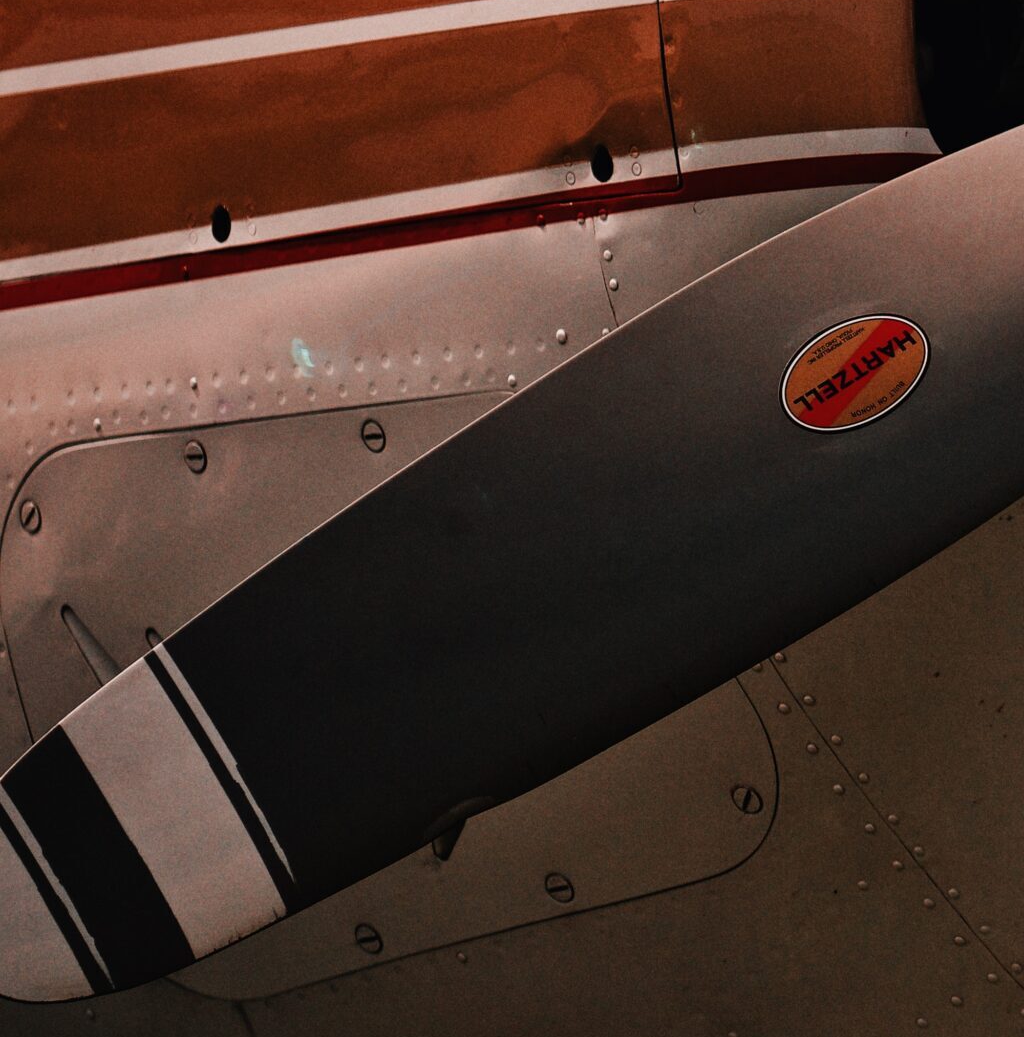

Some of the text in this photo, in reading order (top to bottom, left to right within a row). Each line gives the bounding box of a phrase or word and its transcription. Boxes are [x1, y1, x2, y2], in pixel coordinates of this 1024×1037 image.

[793, 329, 917, 411] HARTZELL
[850, 380, 904, 418] BUILT ON HONOR
